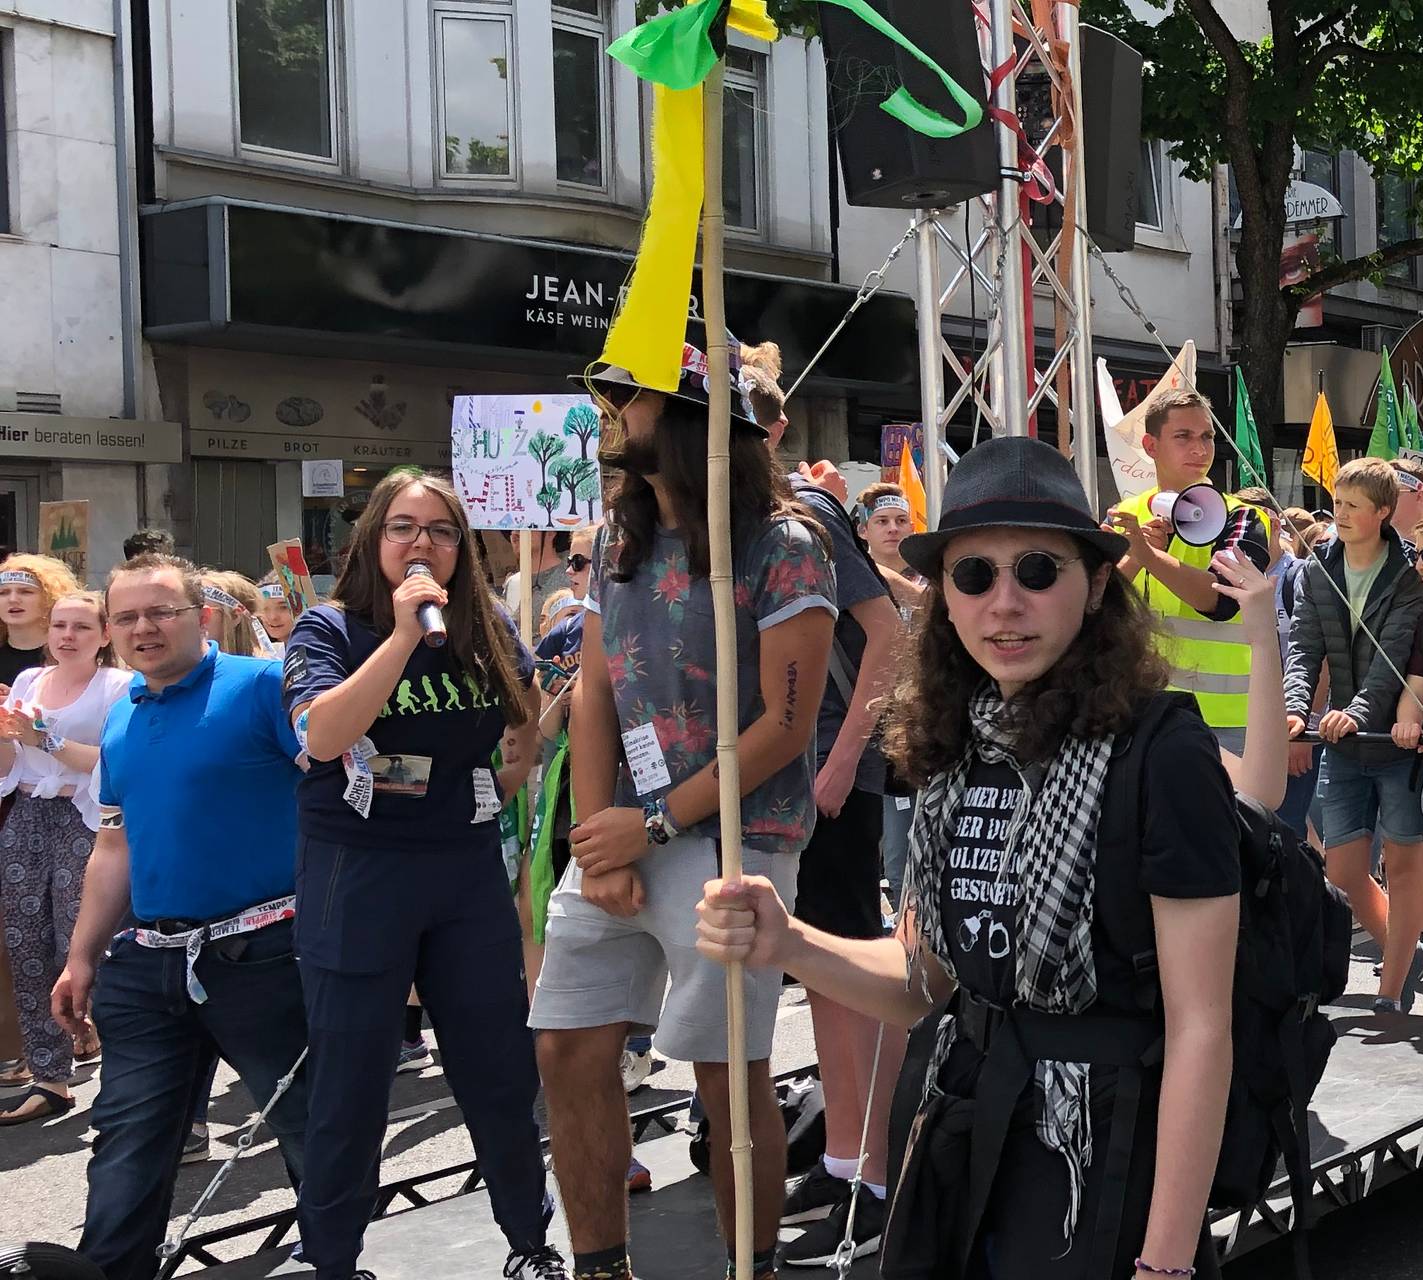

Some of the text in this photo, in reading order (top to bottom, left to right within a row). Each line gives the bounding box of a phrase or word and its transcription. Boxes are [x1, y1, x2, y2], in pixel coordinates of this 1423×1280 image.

[525, 308, 609, 330] KÄSE WEIN
[0, 425, 145, 448] Hier beraten lassen!
[207, 437, 248, 450] PILZE
[283, 441, 320, 454] BROT
